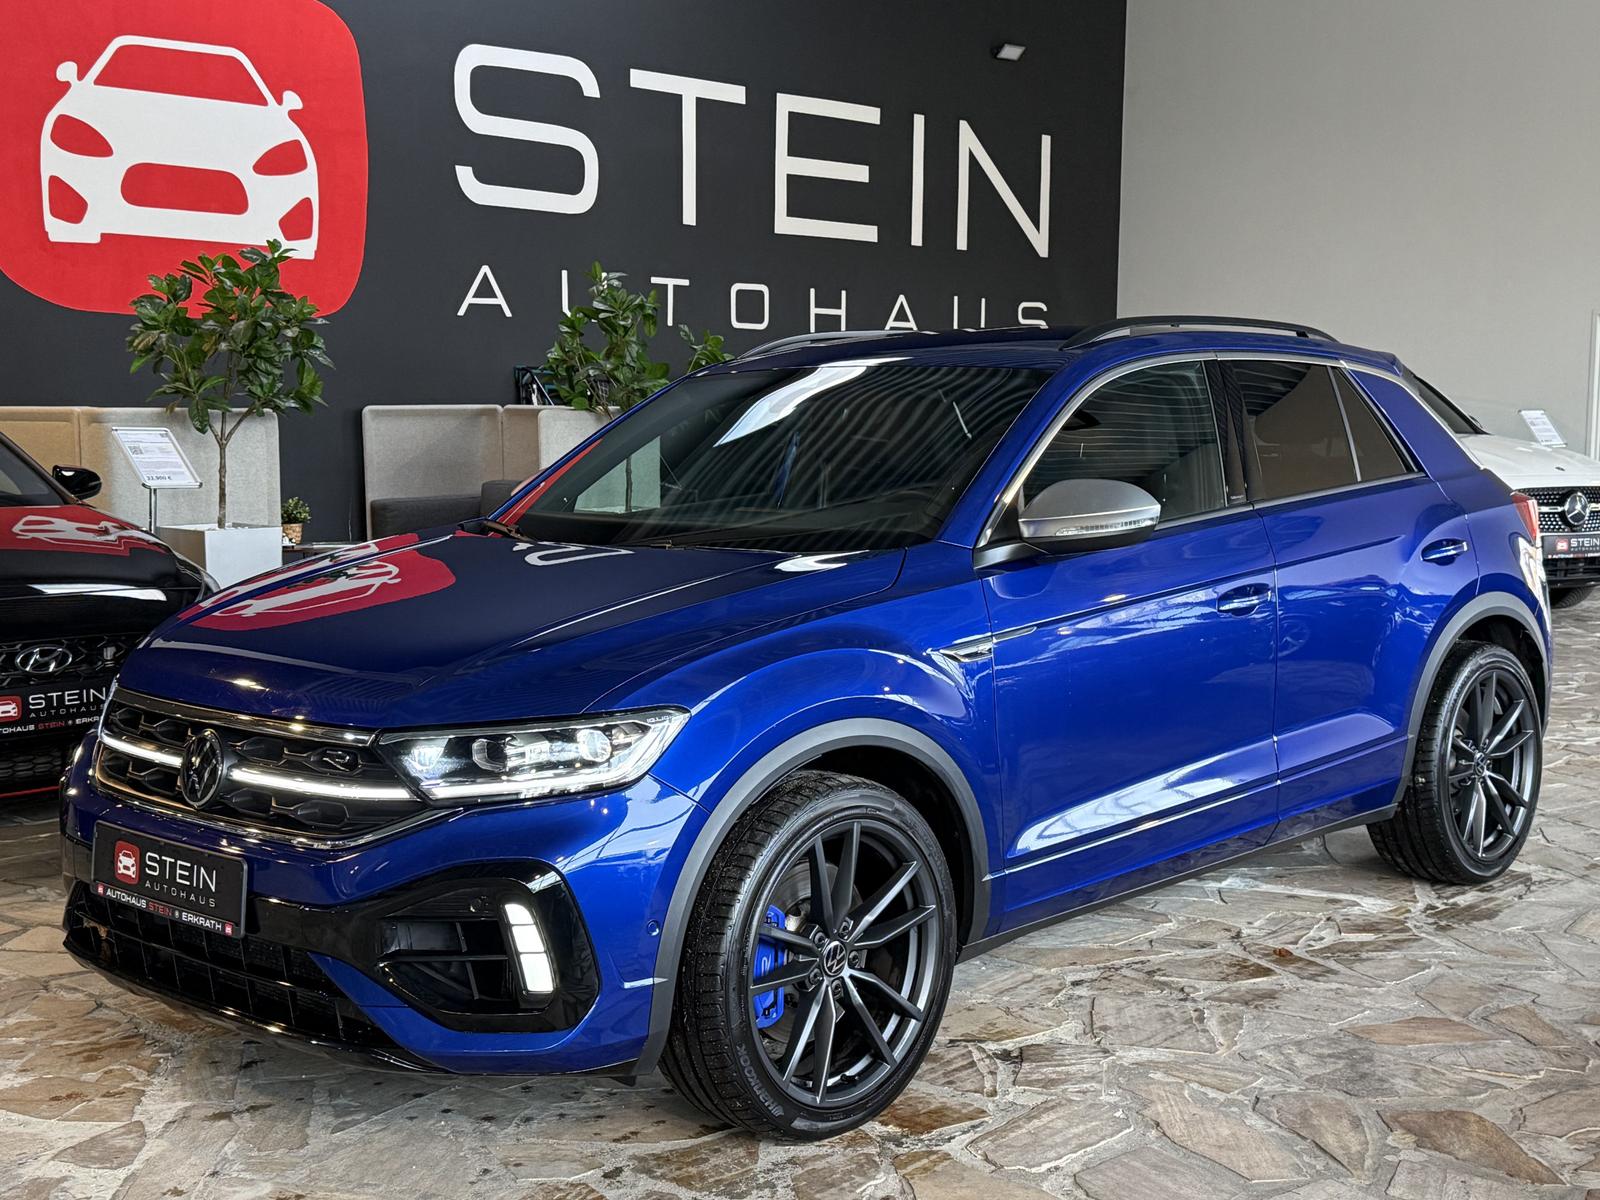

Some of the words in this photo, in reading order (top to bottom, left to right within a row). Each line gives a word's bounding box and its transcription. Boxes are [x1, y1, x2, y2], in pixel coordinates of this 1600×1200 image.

[454, 43, 1051, 257] STEIN
[1570, 537, 1600, 547] STEIN
[28, 687, 106, 709] STEIN
[0, 724, 35, 734] OHAUS
[145, 852, 216, 893] STEIN
[145, 880, 216, 908] AUTOHAUS
[106, 888, 147, 909] AUTOHAUS
[148, 901, 173, 917] STEIN
[181, 912, 222, 932] ERKRATH
